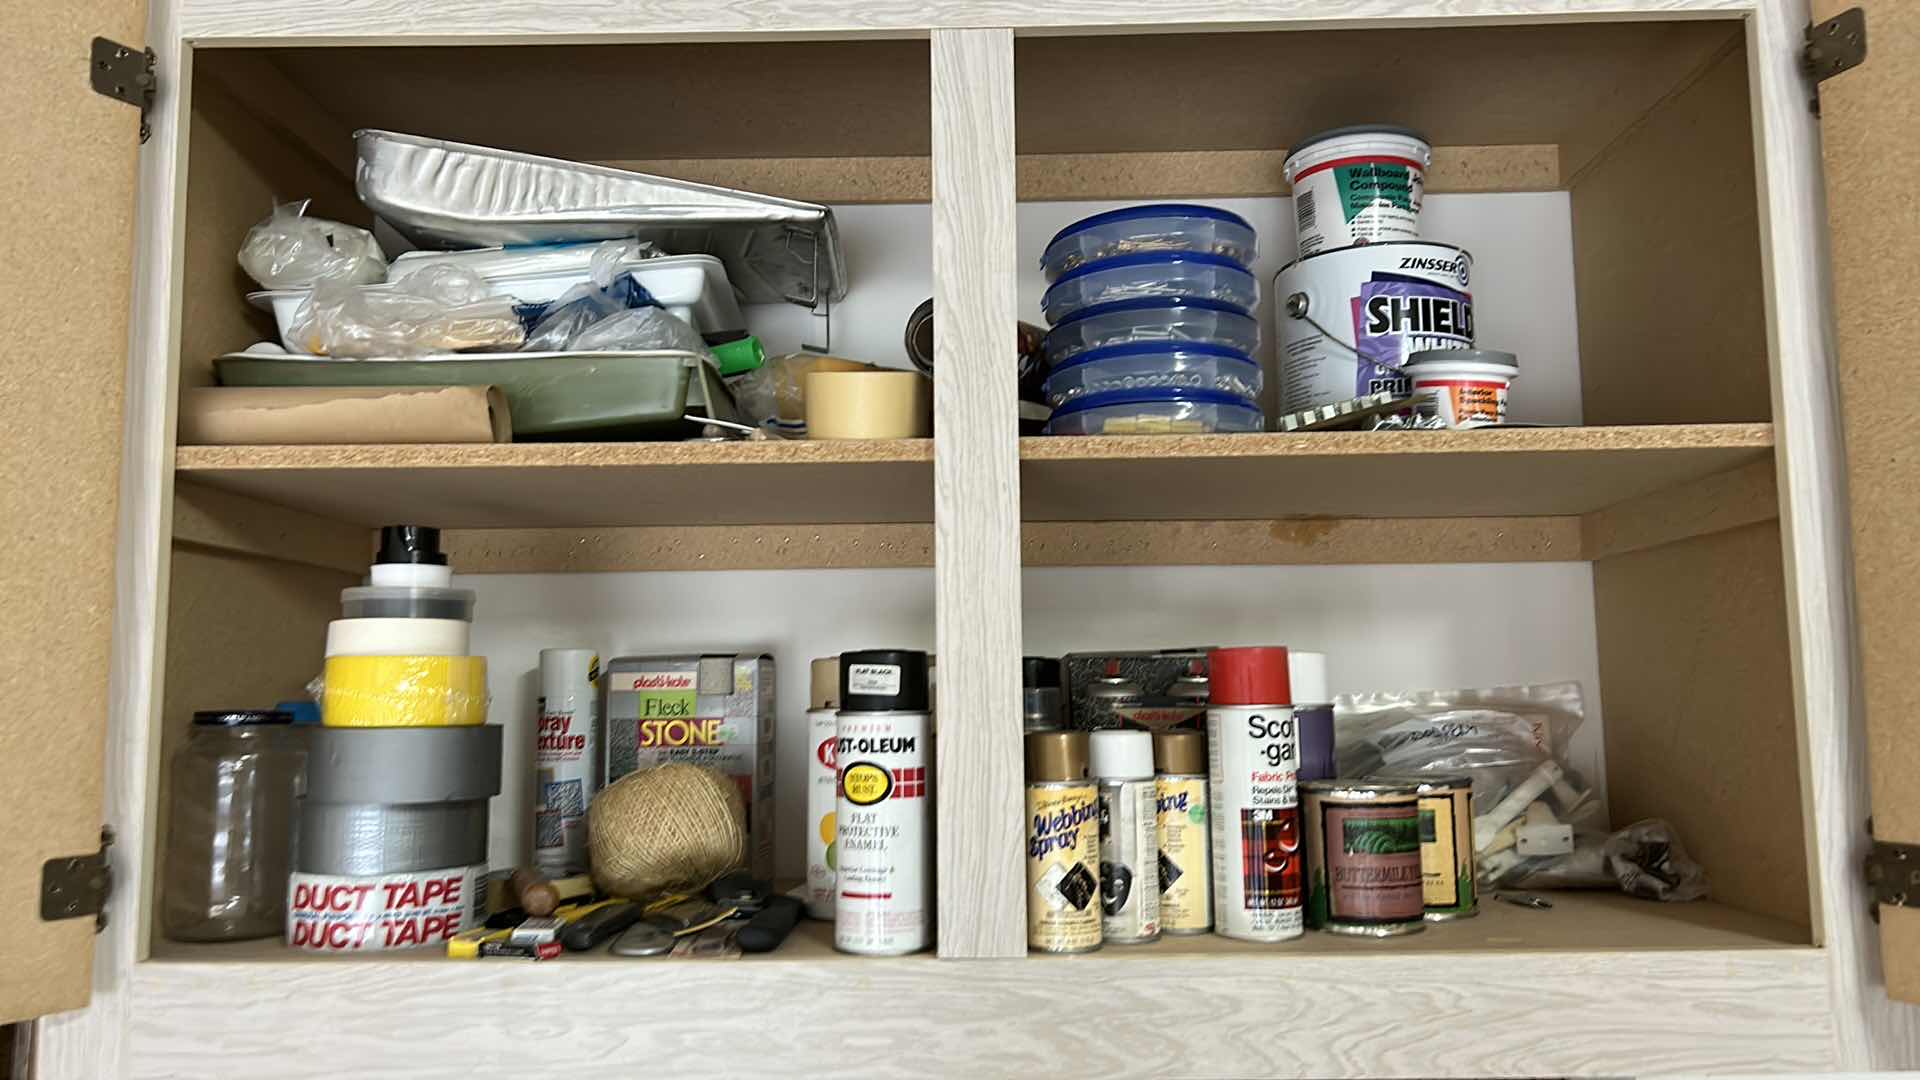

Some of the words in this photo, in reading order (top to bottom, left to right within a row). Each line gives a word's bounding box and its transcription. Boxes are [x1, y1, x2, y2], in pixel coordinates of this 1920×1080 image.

[1349, 166, 1410, 181] Wallboard
[1349, 180, 1413, 193] Compound
[1399, 257, 1458, 273] ZINSSER
[644, 698, 691, 716] Fleck
[537, 714, 572, 736] pray
[640, 719, 723, 747] STONE
[1251, 771, 1282, 783] Fabric
[1252, 796, 1281, 805] Stains
[850, 812, 878, 824] FLAT
[293, 882, 376, 912] DUCT
[382, 876, 464, 910] TAPE
[292, 919, 375, 949] DUCT
[381, 912, 463, 946] TAPE
